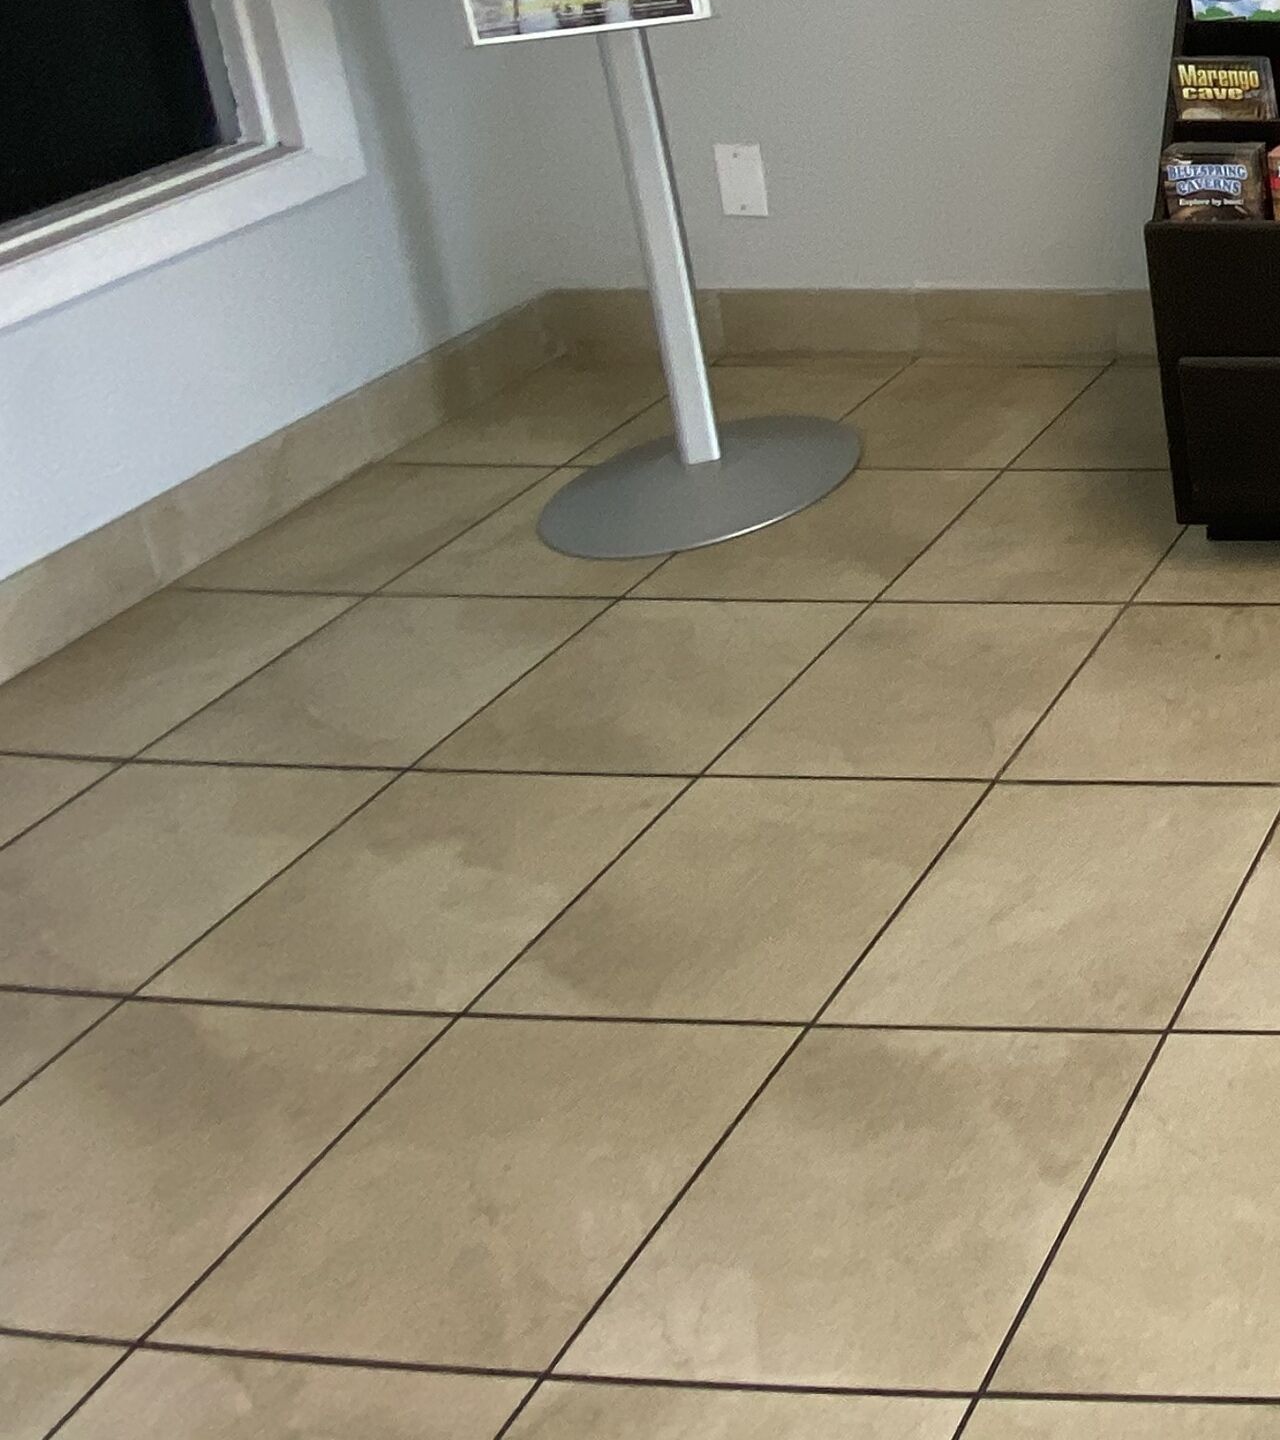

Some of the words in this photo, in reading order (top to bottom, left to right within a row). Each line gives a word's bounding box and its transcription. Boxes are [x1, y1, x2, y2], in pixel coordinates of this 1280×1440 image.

[1177, 64, 1259, 90] Marengo
[1183, 86, 1244, 100] cave
[1167, 164, 1248, 181] BLUESPRING
[1176, 179, 1241, 195] CAVERNS
